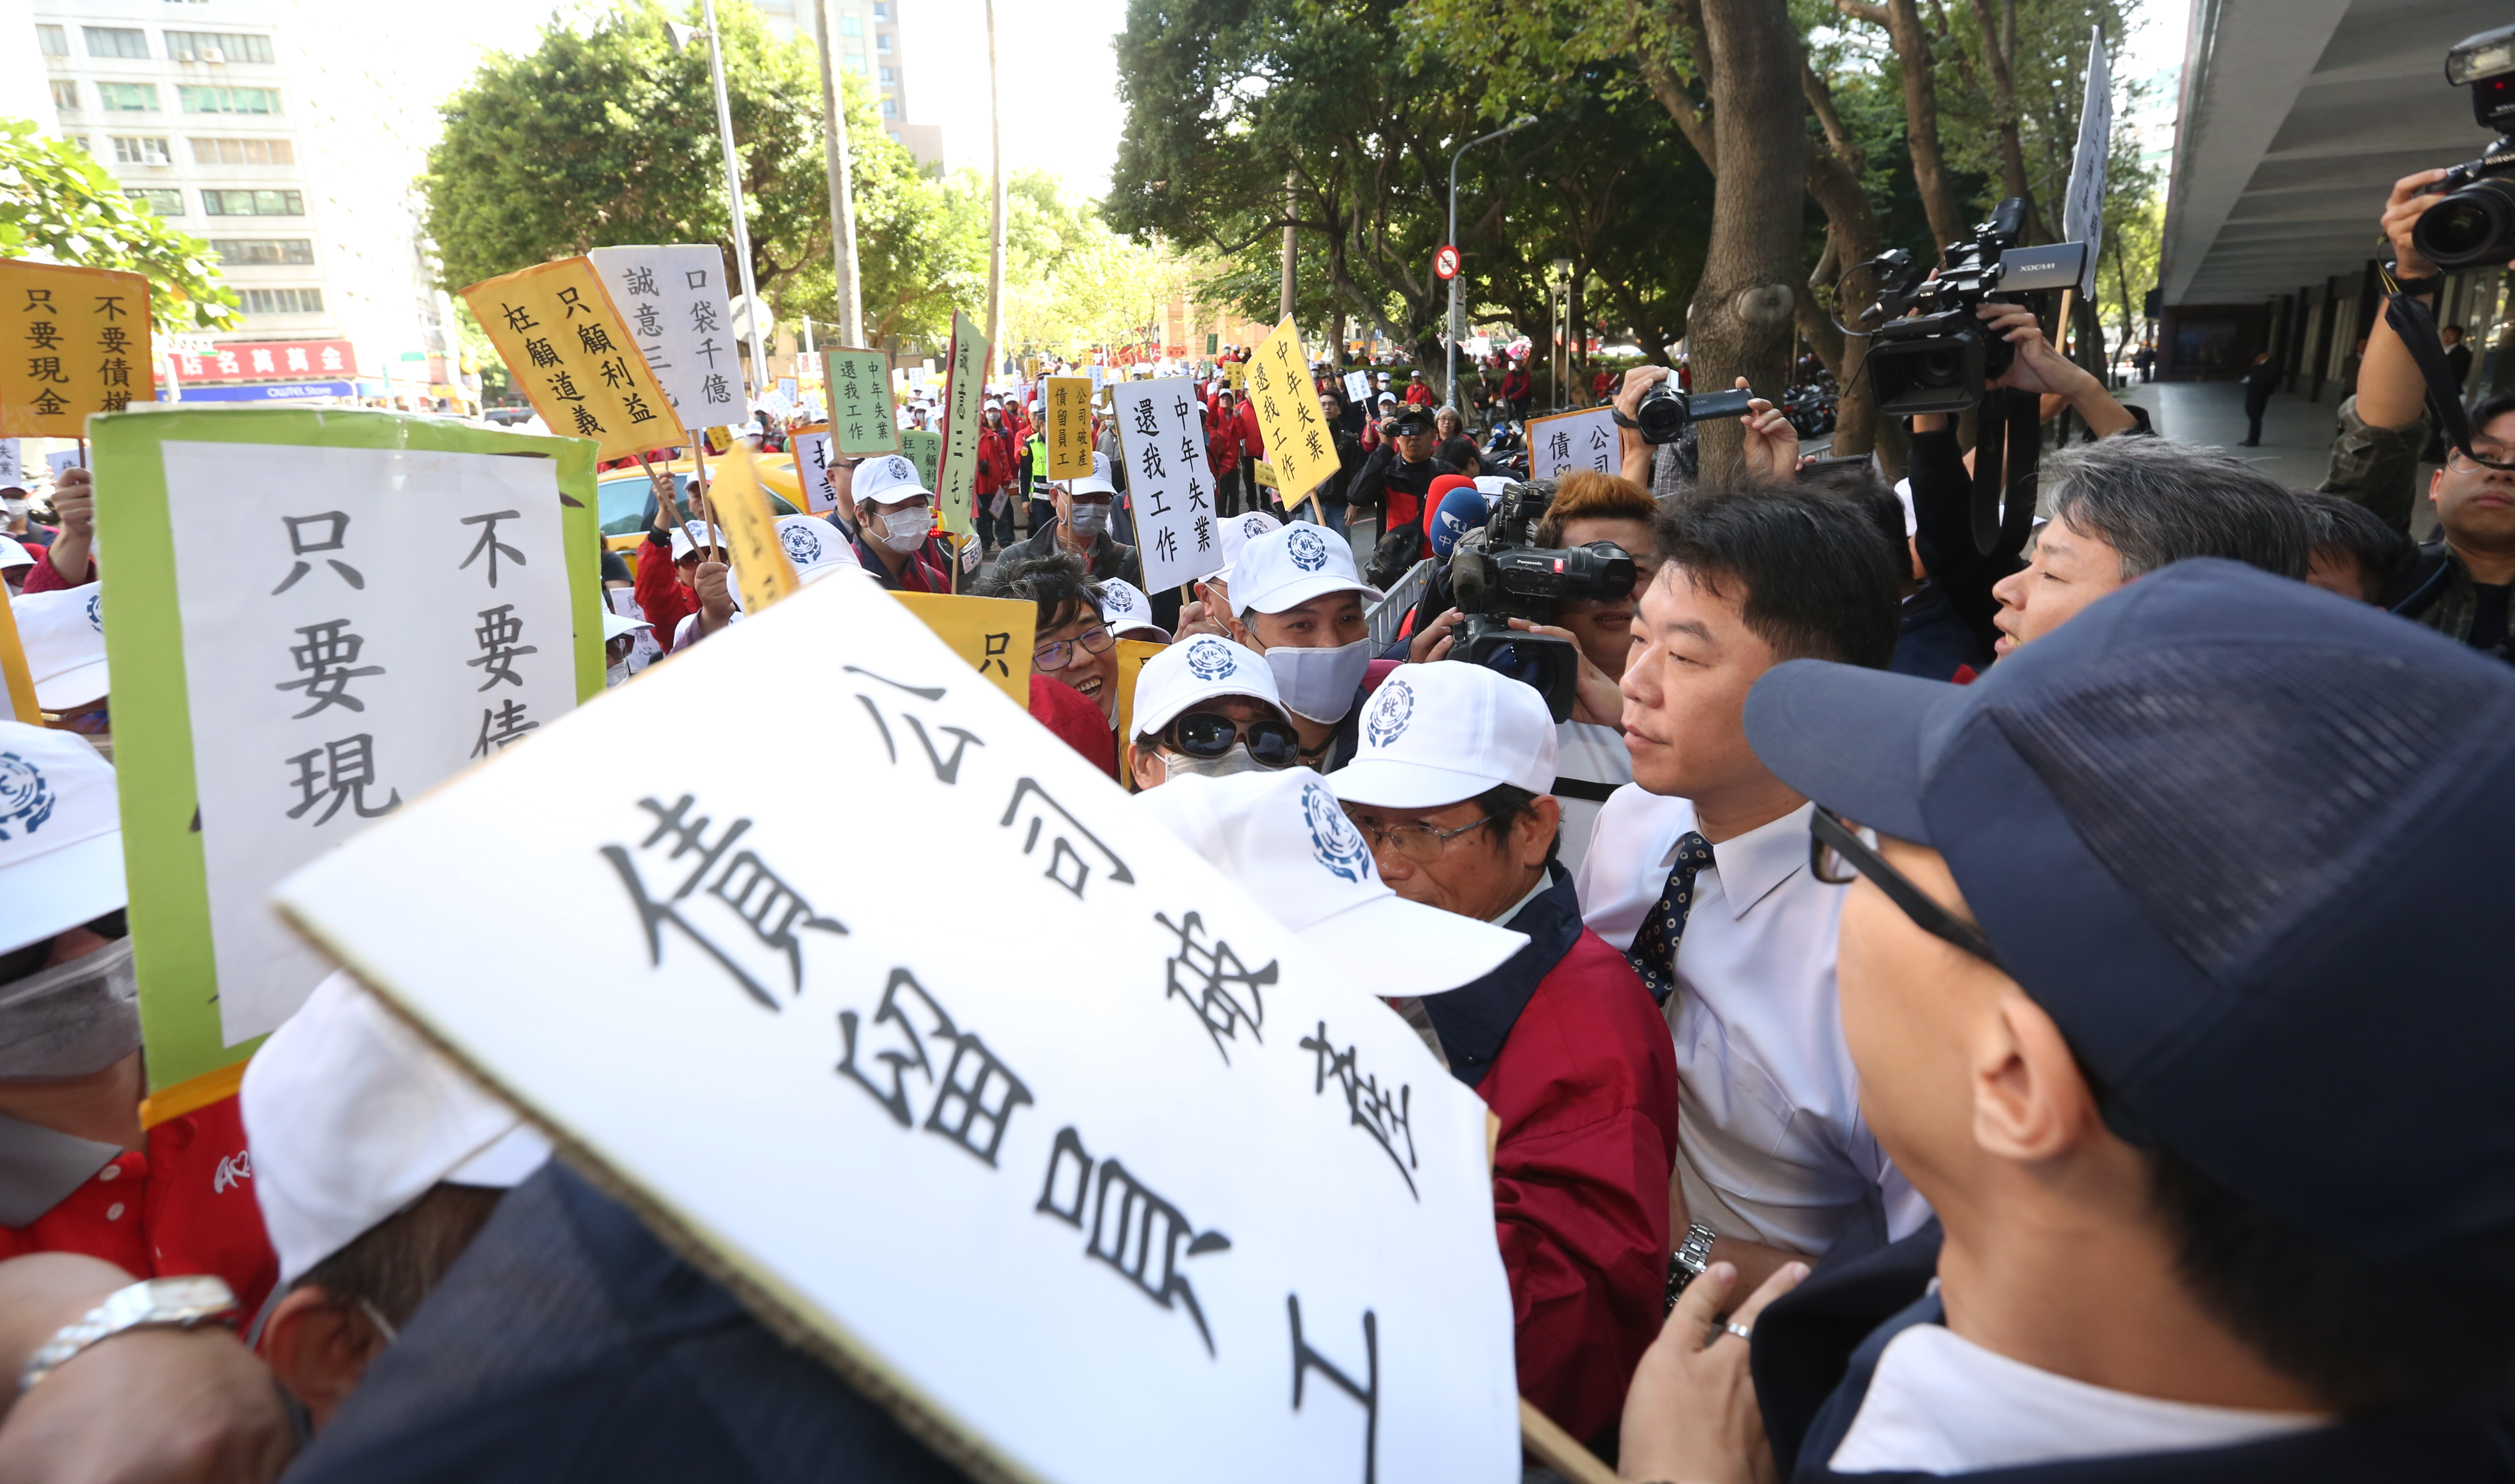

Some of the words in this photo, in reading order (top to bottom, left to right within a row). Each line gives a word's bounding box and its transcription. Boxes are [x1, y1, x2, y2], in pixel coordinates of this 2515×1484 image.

[23, 288, 70, 416] 只要現金
[503, 304, 607, 436] 枉顧道義
[557, 287, 657, 424] 只顧利益
[686, 269, 732, 405] 口袋千億
[840, 360, 863, 440] 還我工作
[868, 361, 888, 439] 中年失業
[1276, 340, 1324, 462] 中年失業
[1055, 387, 1069, 465] 債留員工
[1076, 388, 1088, 467] 公司破產
[1134, 398, 1178, 562] 還我工作
[1174, 394, 1210, 553] 中年失業
[1255, 362, 1295, 482] 還我工作
[1590, 426, 1610, 474] 公司
[270, 510, 403, 827] 只要現
[979, 632, 1010, 677] 只
[842, 665, 1419, 1200] 公司破產
[600, 793, 1378, 1484] 債留員工
